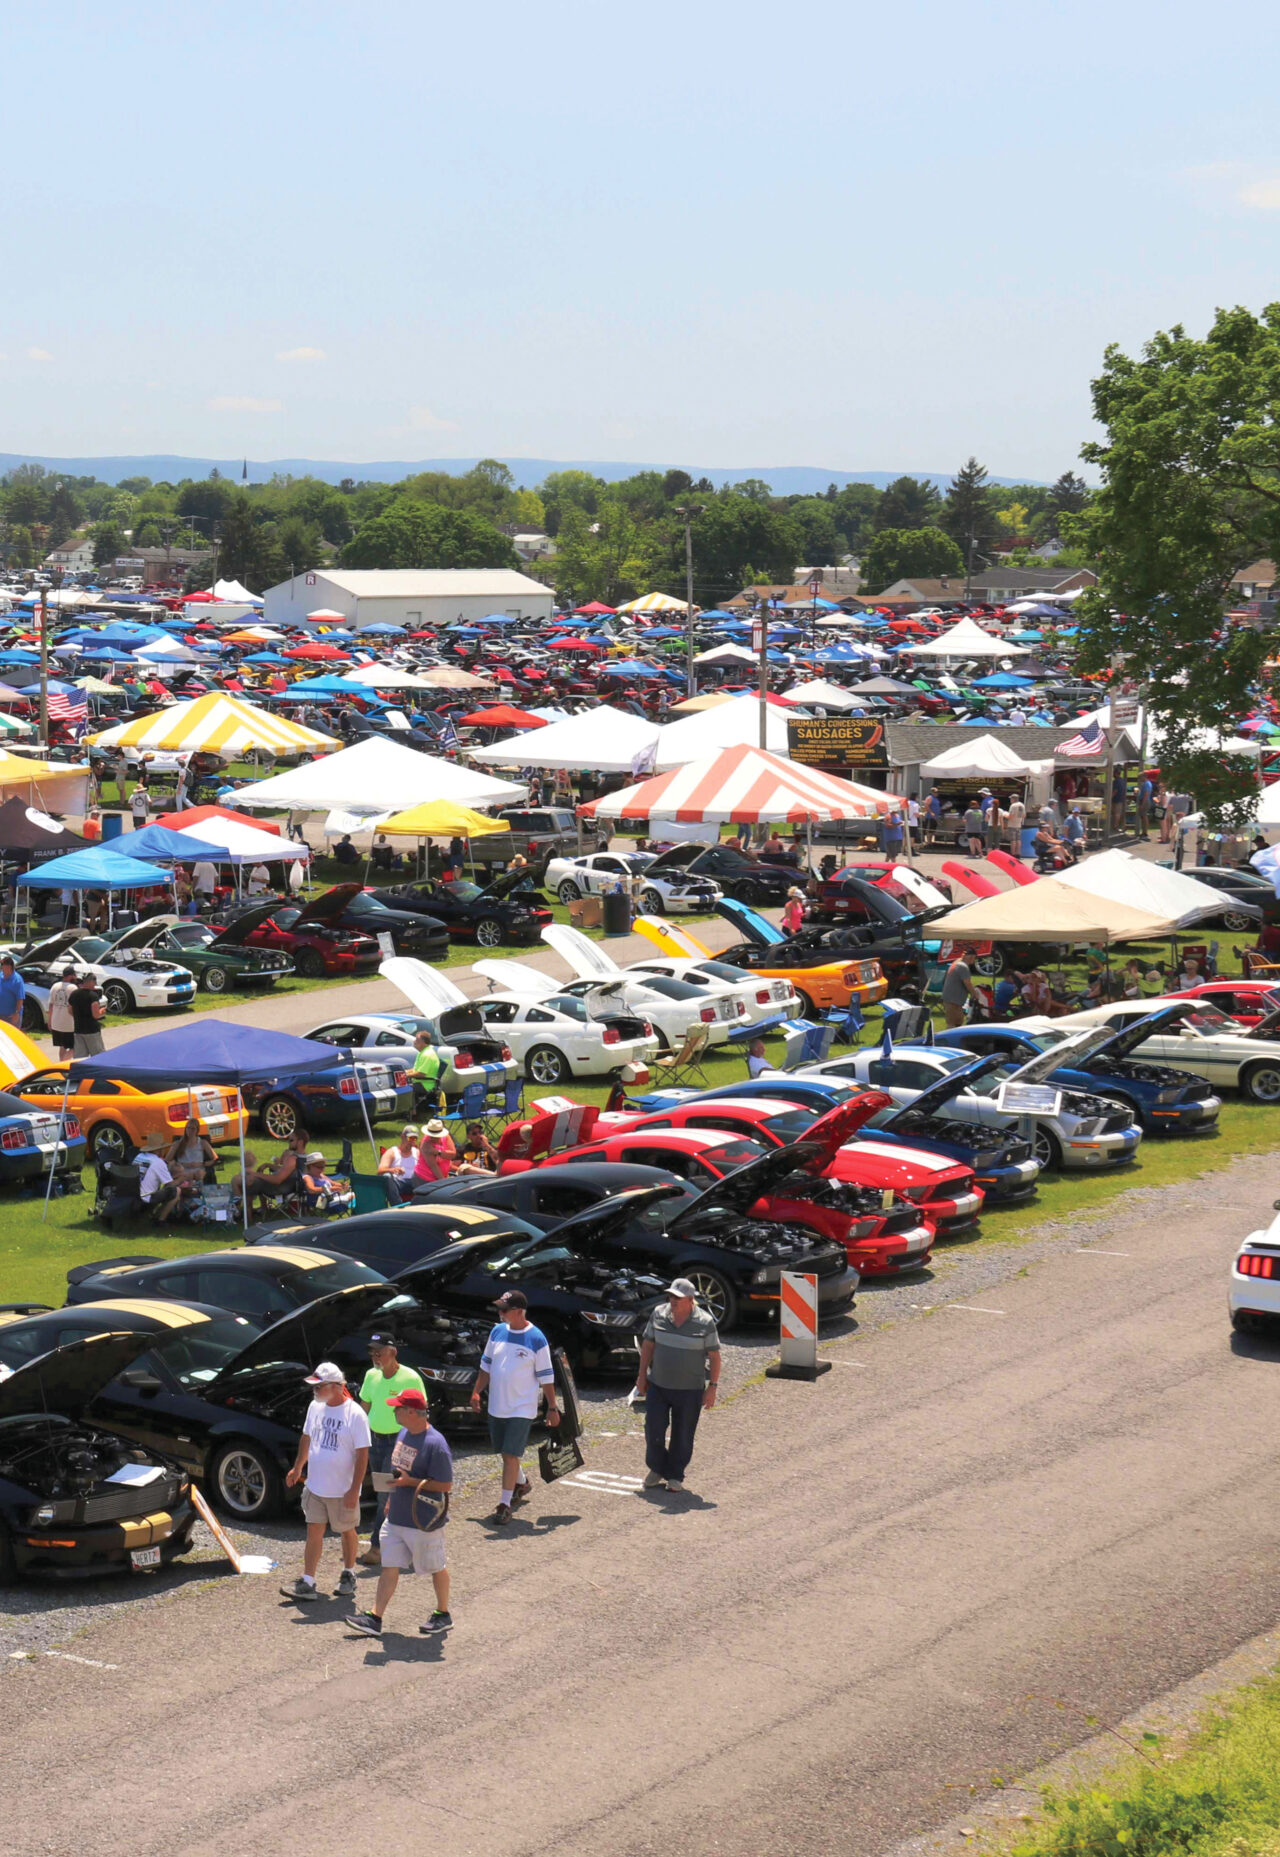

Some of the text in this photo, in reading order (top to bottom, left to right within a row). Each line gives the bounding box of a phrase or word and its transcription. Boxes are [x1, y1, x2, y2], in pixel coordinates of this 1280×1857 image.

[789, 719, 879, 728] SHUMAN'S CONCESSIONS
[797, 727, 862, 739] SAUSAGES
[33, 849, 57, 858] FRANK
